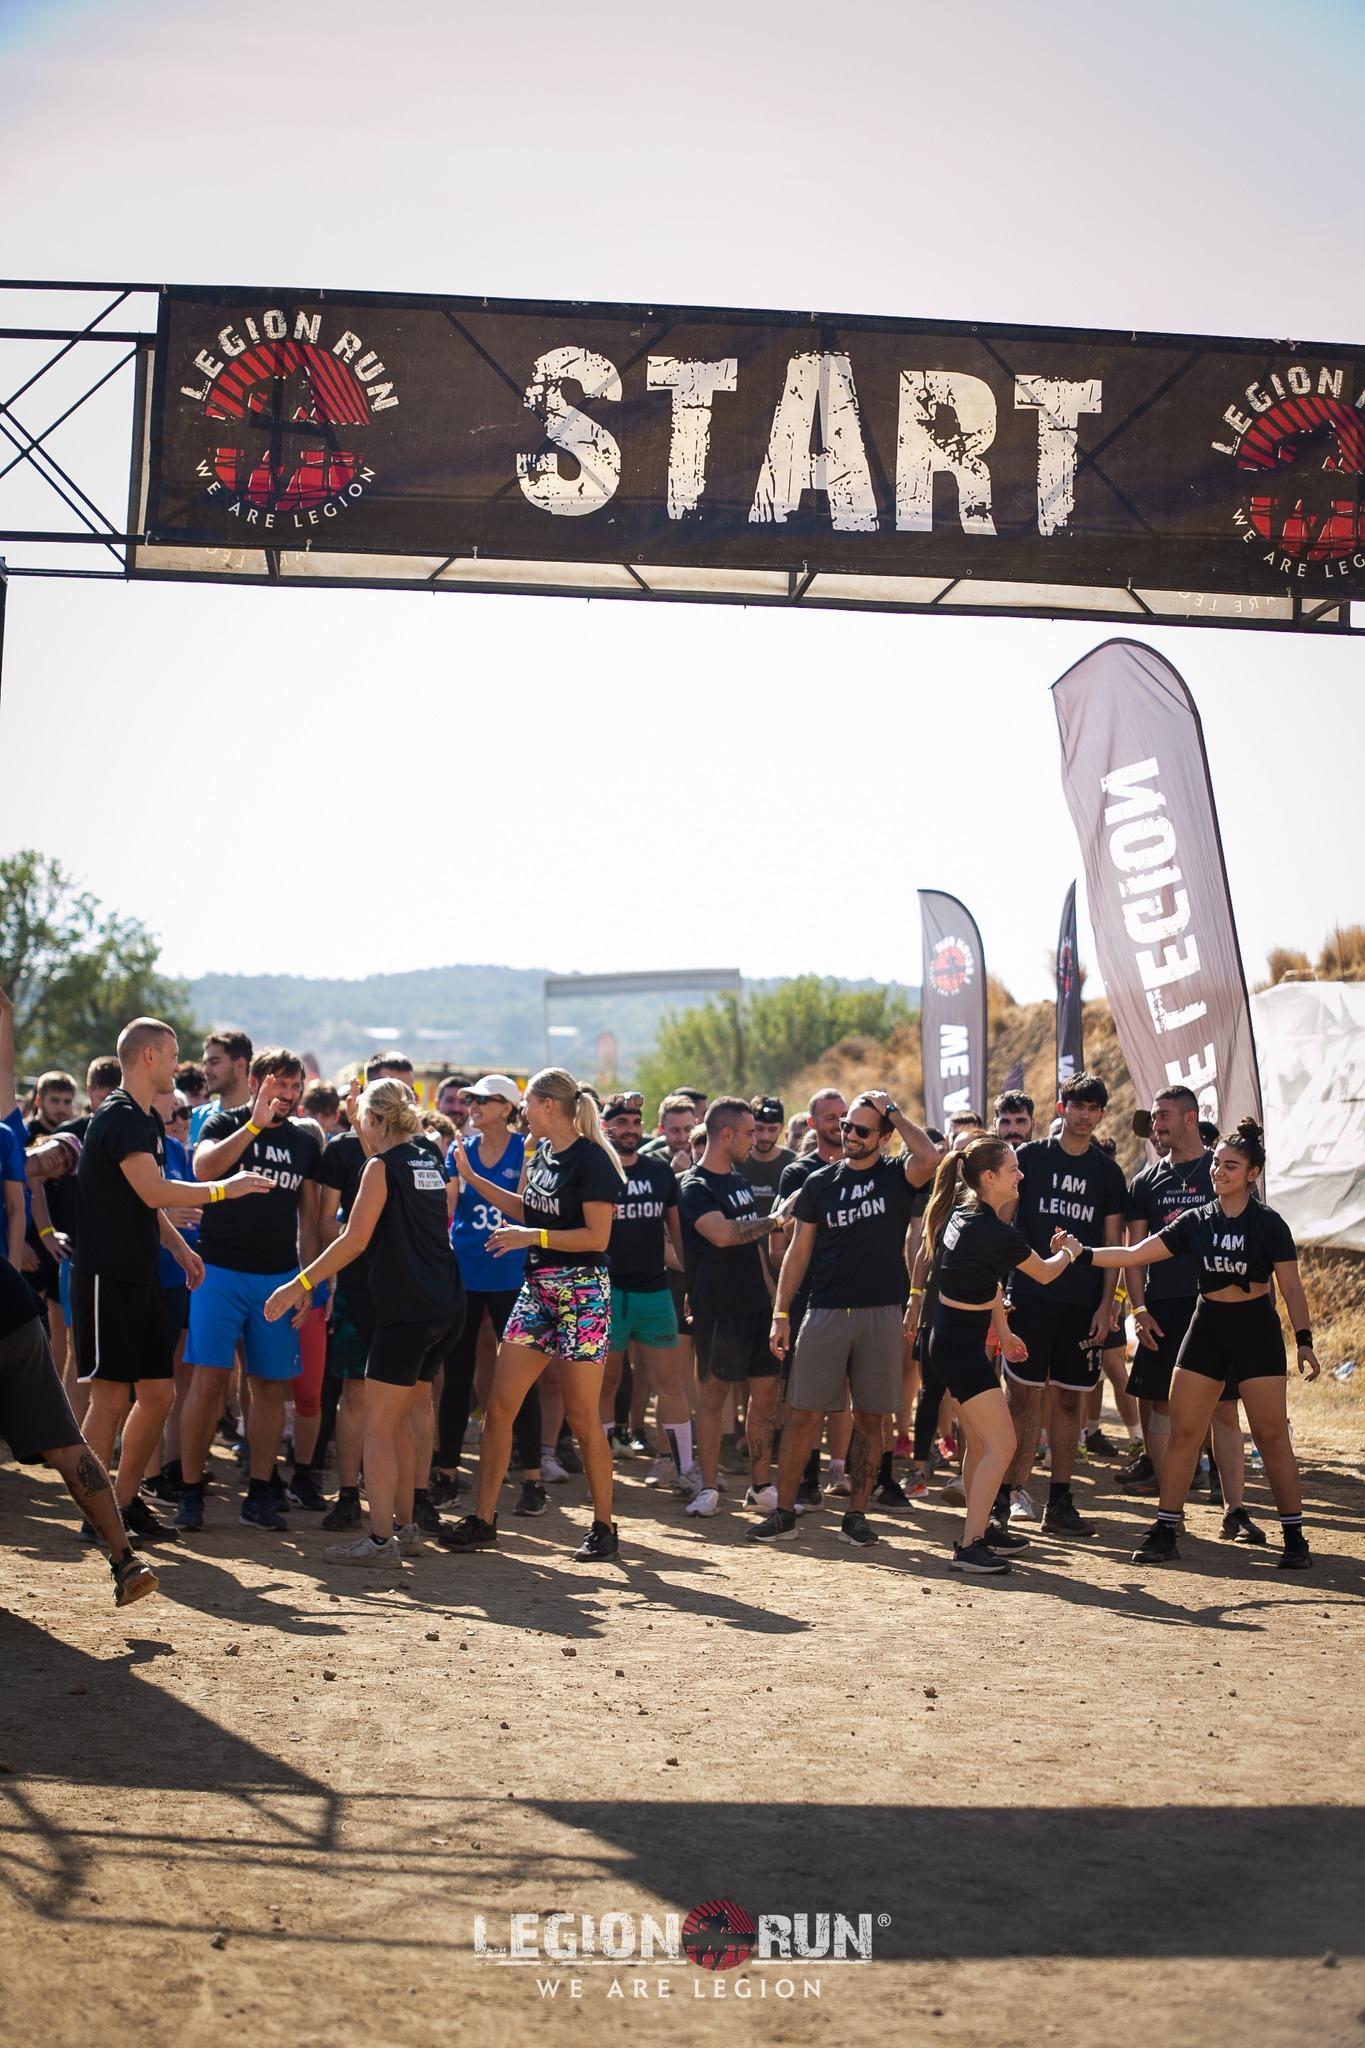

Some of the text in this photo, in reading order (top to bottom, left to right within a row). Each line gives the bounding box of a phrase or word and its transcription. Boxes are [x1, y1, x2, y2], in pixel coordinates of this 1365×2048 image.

[180, 309, 400, 412] LEGION RUN
[1211, 366, 1343, 456] LEGION
[516, 346, 1102, 537] START
[195, 459, 376, 529] WE ARE LEGION
[1232, 508, 1256, 544] WE
[1262, 551, 1307, 578] ARE
[253, 1142, 292, 1164] I AM
[538, 1169, 559, 1190] AM
[627, 1179, 652, 1195] AM
[839, 1179, 875, 1201] I AM
[1052, 1173, 1086, 1195] I AM
[525, 1188, 560, 1216] EGION
[728, 1189, 754, 1208] I AM
[1039, 1197, 1095, 1222] LEGION
[1162, 1196, 1175, 1205] AM
[1176, 1195, 1206, 1204] LEGION
[472, 1205, 502, 1231] 33
[613, 1202, 663, 1220] EGION
[826, 1197, 886, 1228] LEGION
[1213, 1233, 1245, 1251] I AM
